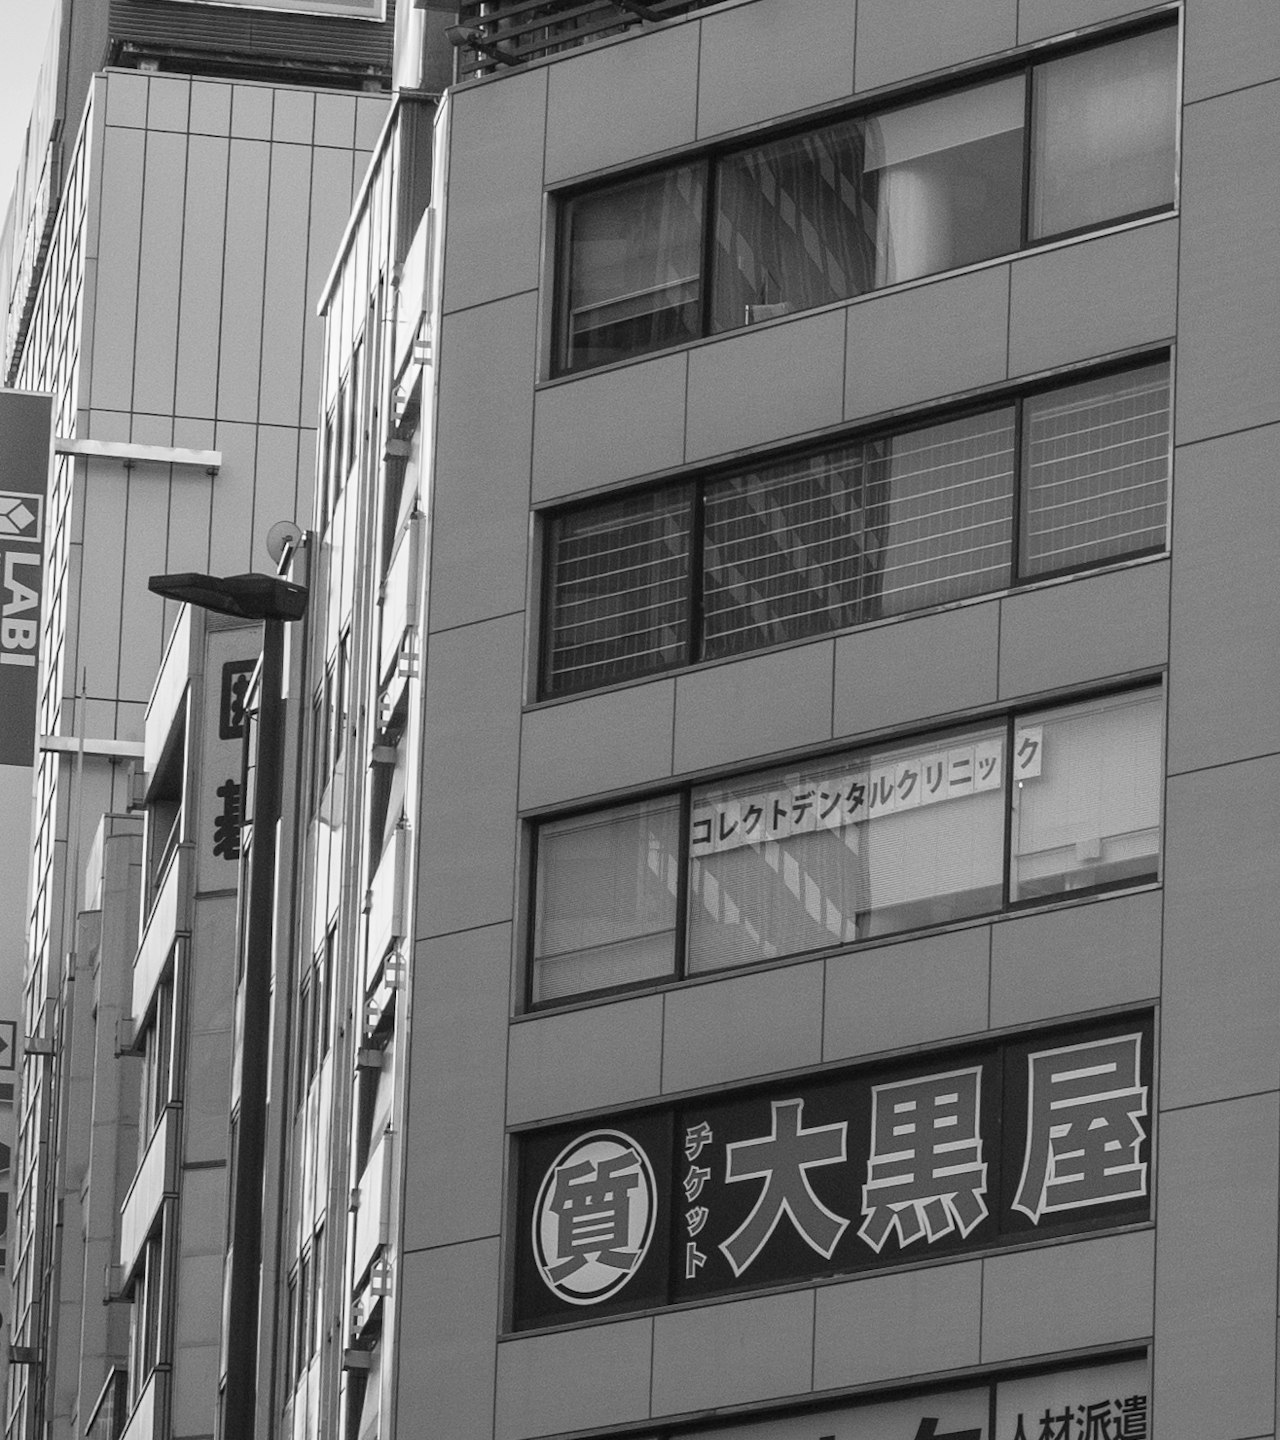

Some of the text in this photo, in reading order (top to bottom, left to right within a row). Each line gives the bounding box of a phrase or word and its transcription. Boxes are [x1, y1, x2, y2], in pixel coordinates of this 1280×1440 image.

[1, 550, 42, 668] LABI
[691, 736, 1041, 847] コレクトデンタルクリニック
[543, 1147, 643, 1289] 質
[684, 1120, 713, 1280] チケット
[719, 1031, 1148, 1278] 大黒屋
